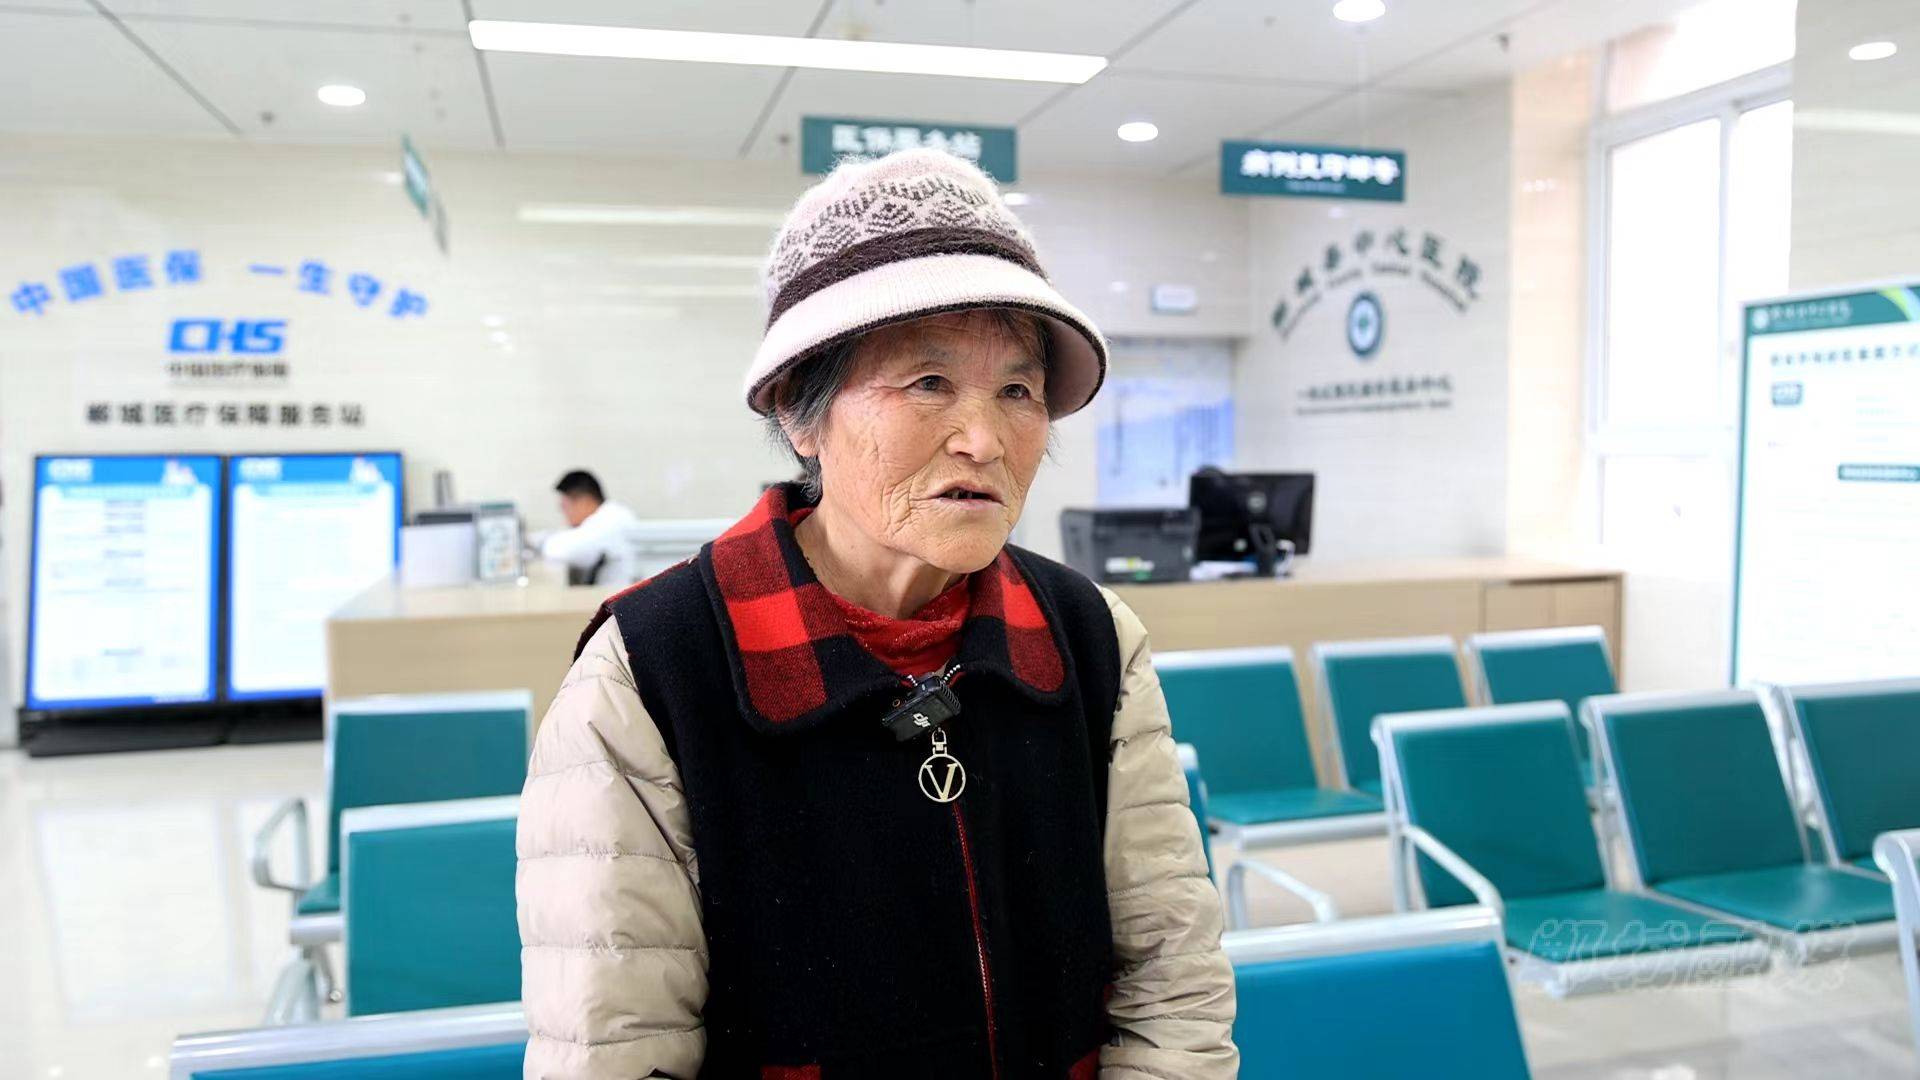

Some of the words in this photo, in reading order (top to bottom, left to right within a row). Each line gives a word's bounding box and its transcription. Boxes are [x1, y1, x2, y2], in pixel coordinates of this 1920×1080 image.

[10, 250, 203, 316] 中国医保
[247, 258, 429, 318] 一生守护
